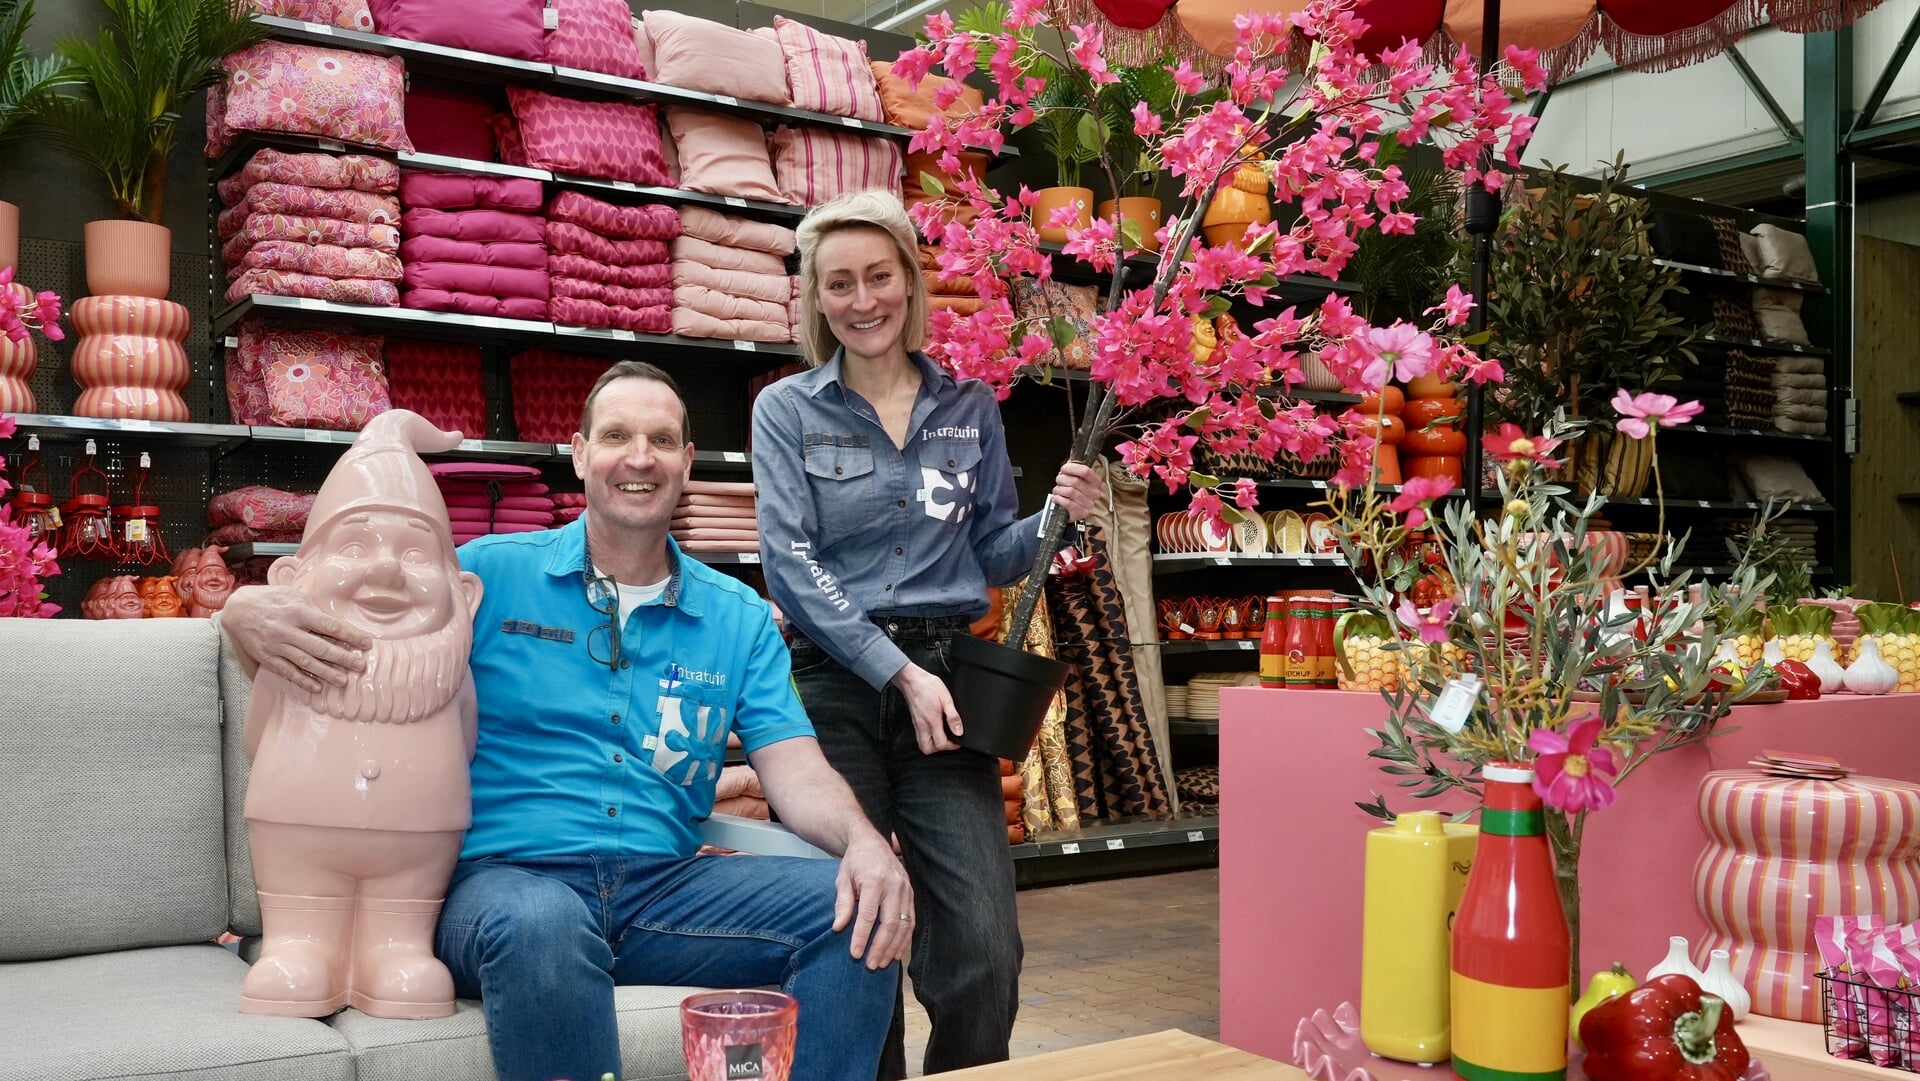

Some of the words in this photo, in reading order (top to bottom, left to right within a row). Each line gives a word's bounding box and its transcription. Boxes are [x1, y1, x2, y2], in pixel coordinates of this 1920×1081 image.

[922, 425, 979, 441] Intratuin
[791, 541, 850, 612] Inratuin
[670, 662, 726, 686] Intratuin
